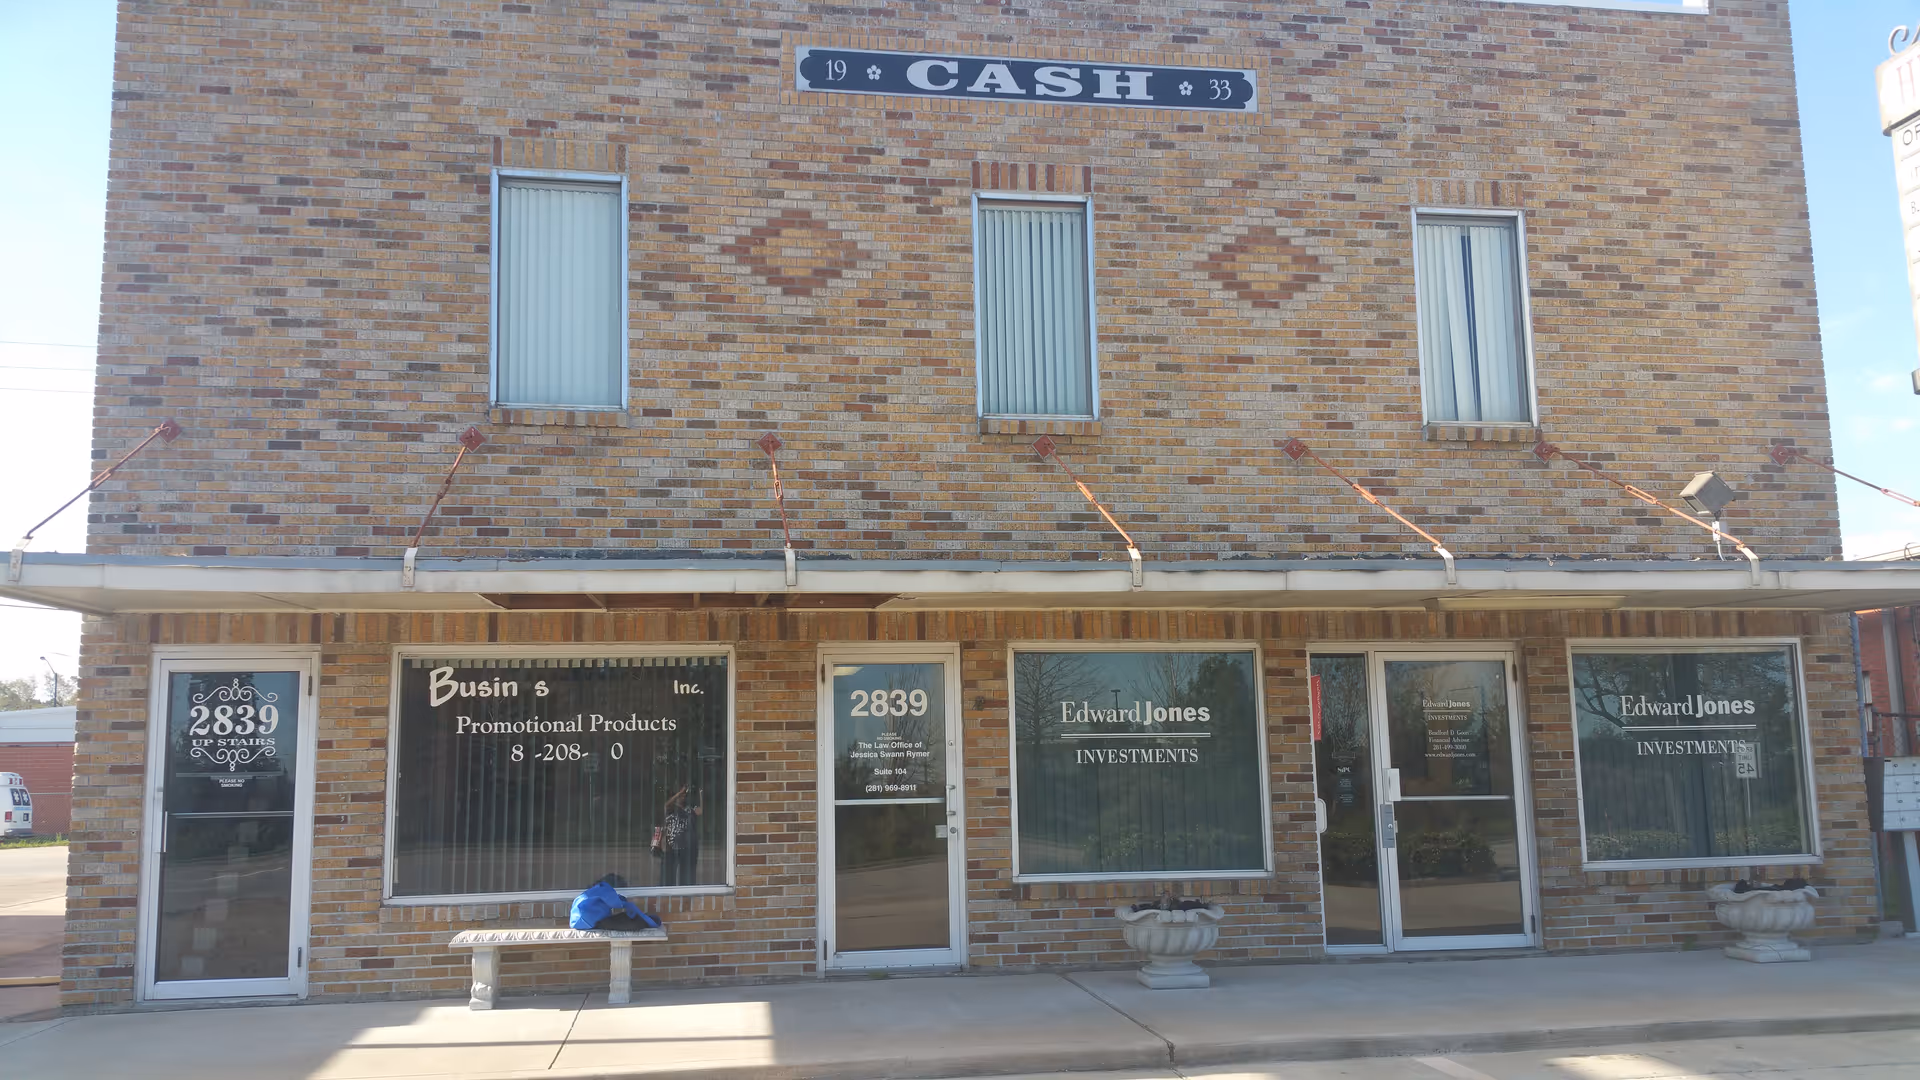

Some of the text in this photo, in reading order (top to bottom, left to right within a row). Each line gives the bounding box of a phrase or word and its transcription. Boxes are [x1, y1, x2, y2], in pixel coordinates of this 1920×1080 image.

[824, 59, 1232, 101] 19 CASH 33
[673, 680, 704, 695] Inc.
[848, 689, 928, 717] 2839
[189, 704, 279, 736] 2839
[456, 714, 677, 734] Promotional Products
[192, 738, 275, 747] UP STAIRS
[858, 740, 923, 749] The Law Office of
[1637, 739, 1747, 756] INVESTMENTS
[906, 750, 930, 760] Rymer
[1076, 748, 1199, 764] INVESTMENTS
[865, 784, 883, 793] (281)
